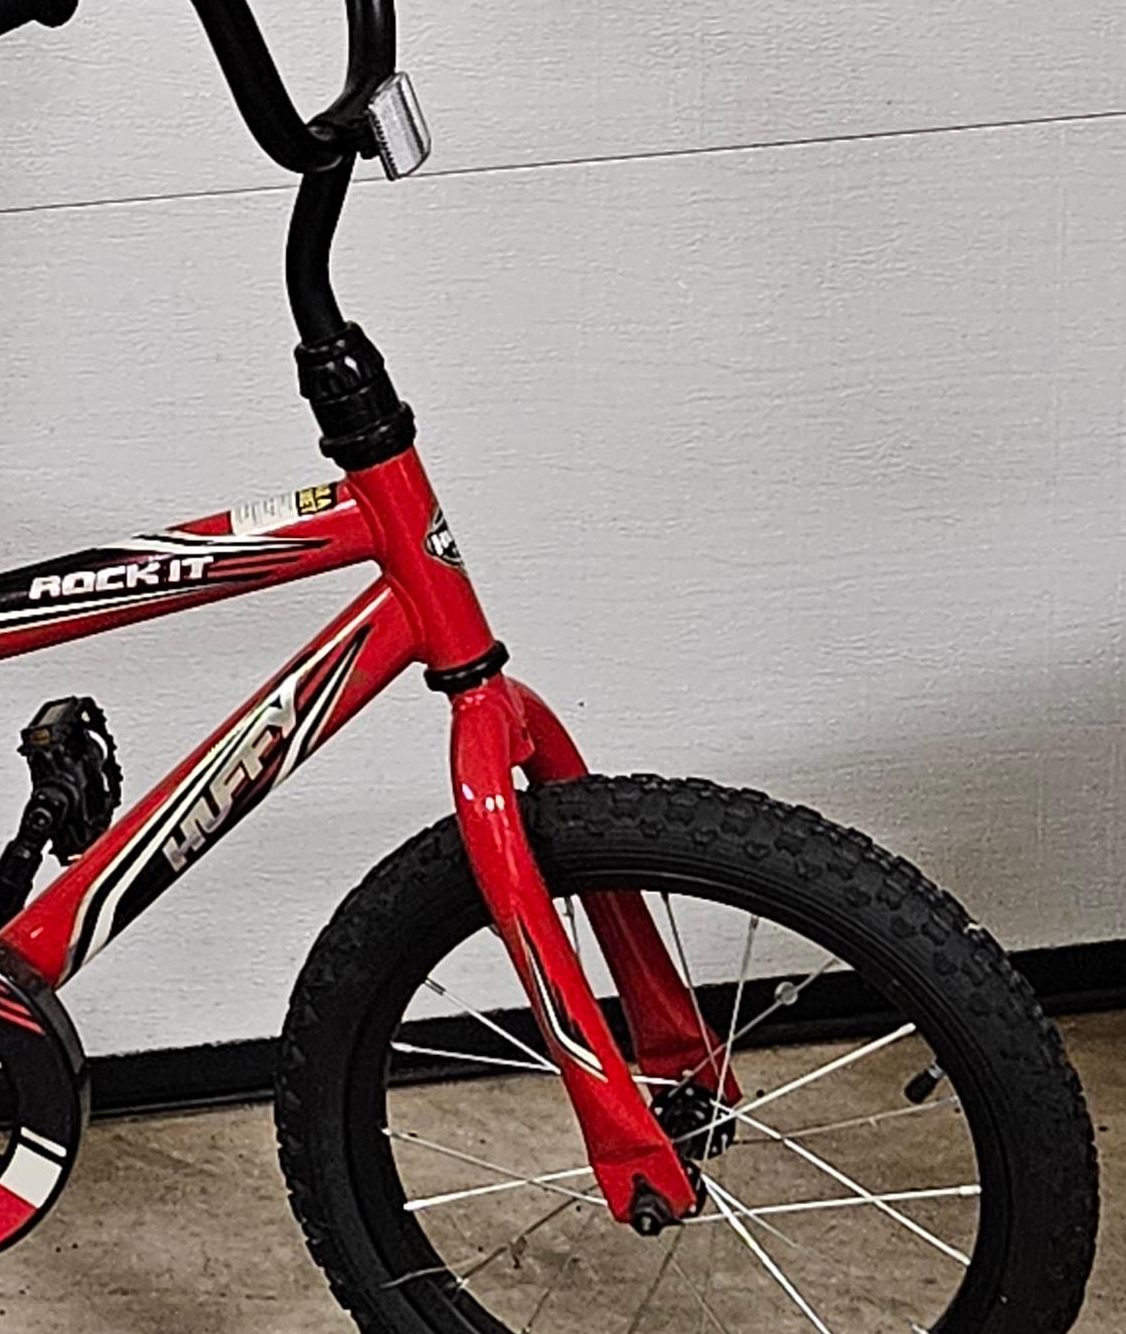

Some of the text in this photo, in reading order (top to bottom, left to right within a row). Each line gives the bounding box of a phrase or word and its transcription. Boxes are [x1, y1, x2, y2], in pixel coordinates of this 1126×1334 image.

[28, 555, 214, 600] ROCK IT
[162, 675, 297, 871] HUFFY
